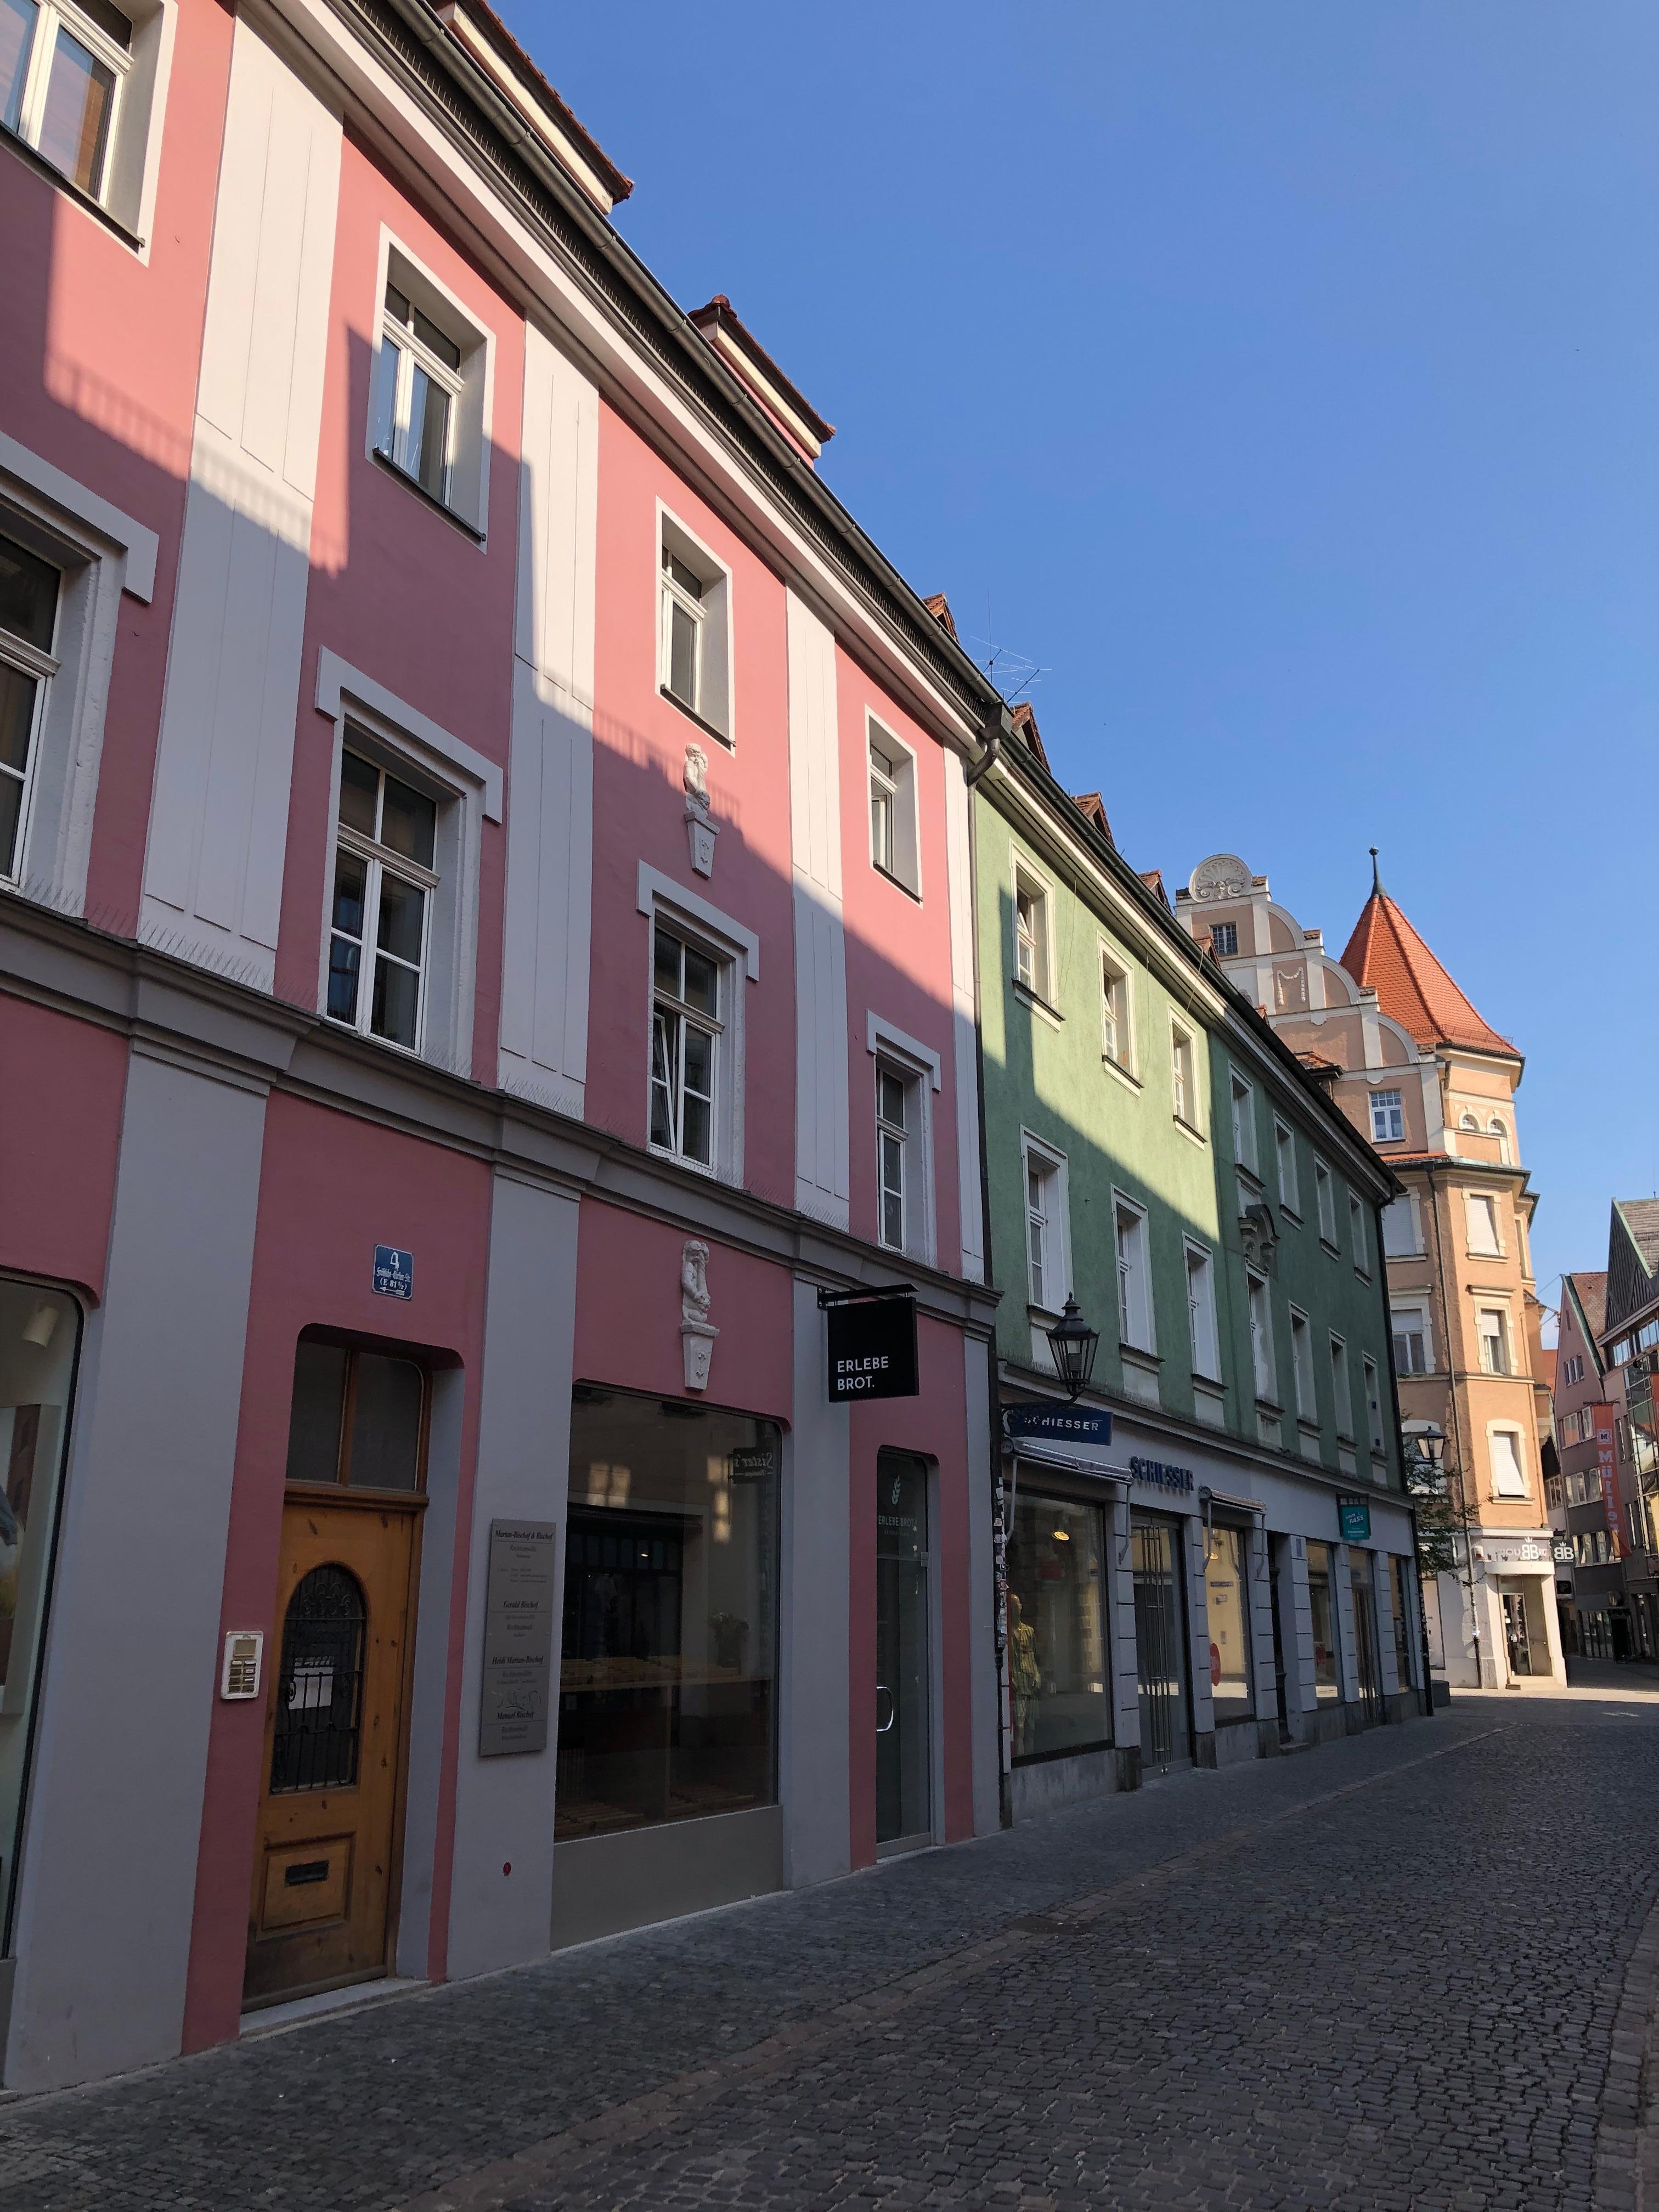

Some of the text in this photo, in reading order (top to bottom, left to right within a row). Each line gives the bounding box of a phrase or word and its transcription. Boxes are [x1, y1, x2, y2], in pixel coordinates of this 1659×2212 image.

[390, 1251, 399, 1271] 4
[837, 1356, 889, 1373] ERLEBE
[838, 1376, 875, 1391] BROT.
[1130, 1456, 1195, 1491] SCHIESSER
[878, 1515, 899, 1526] ERLEBE
[1349, 1515, 1364, 1524] FASS
[503, 1600, 520, 1609] Gerald
